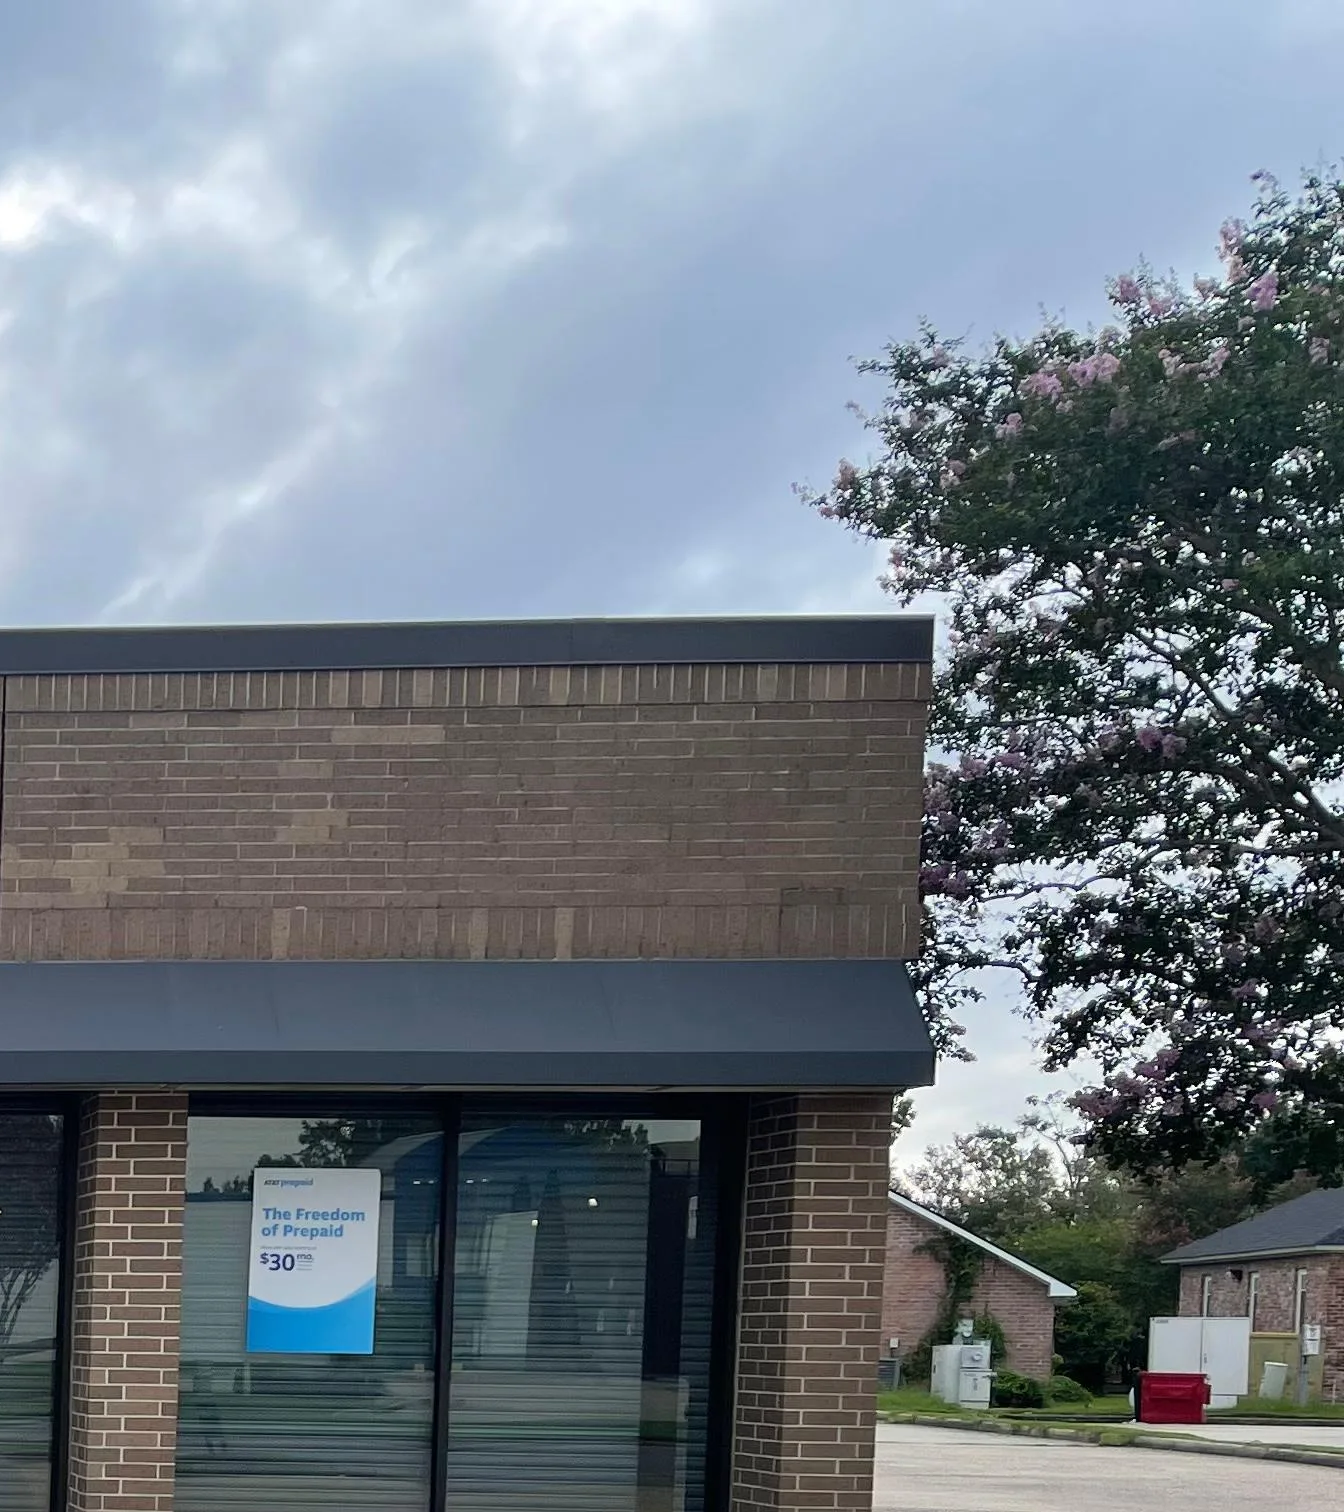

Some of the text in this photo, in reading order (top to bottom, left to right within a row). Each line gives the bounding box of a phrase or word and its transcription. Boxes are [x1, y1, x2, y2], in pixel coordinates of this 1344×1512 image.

[262, 1207, 365, 1222] The Freedom
[261, 1224, 344, 1240] of Prepaid
[260, 1252, 295, 1271] $30
